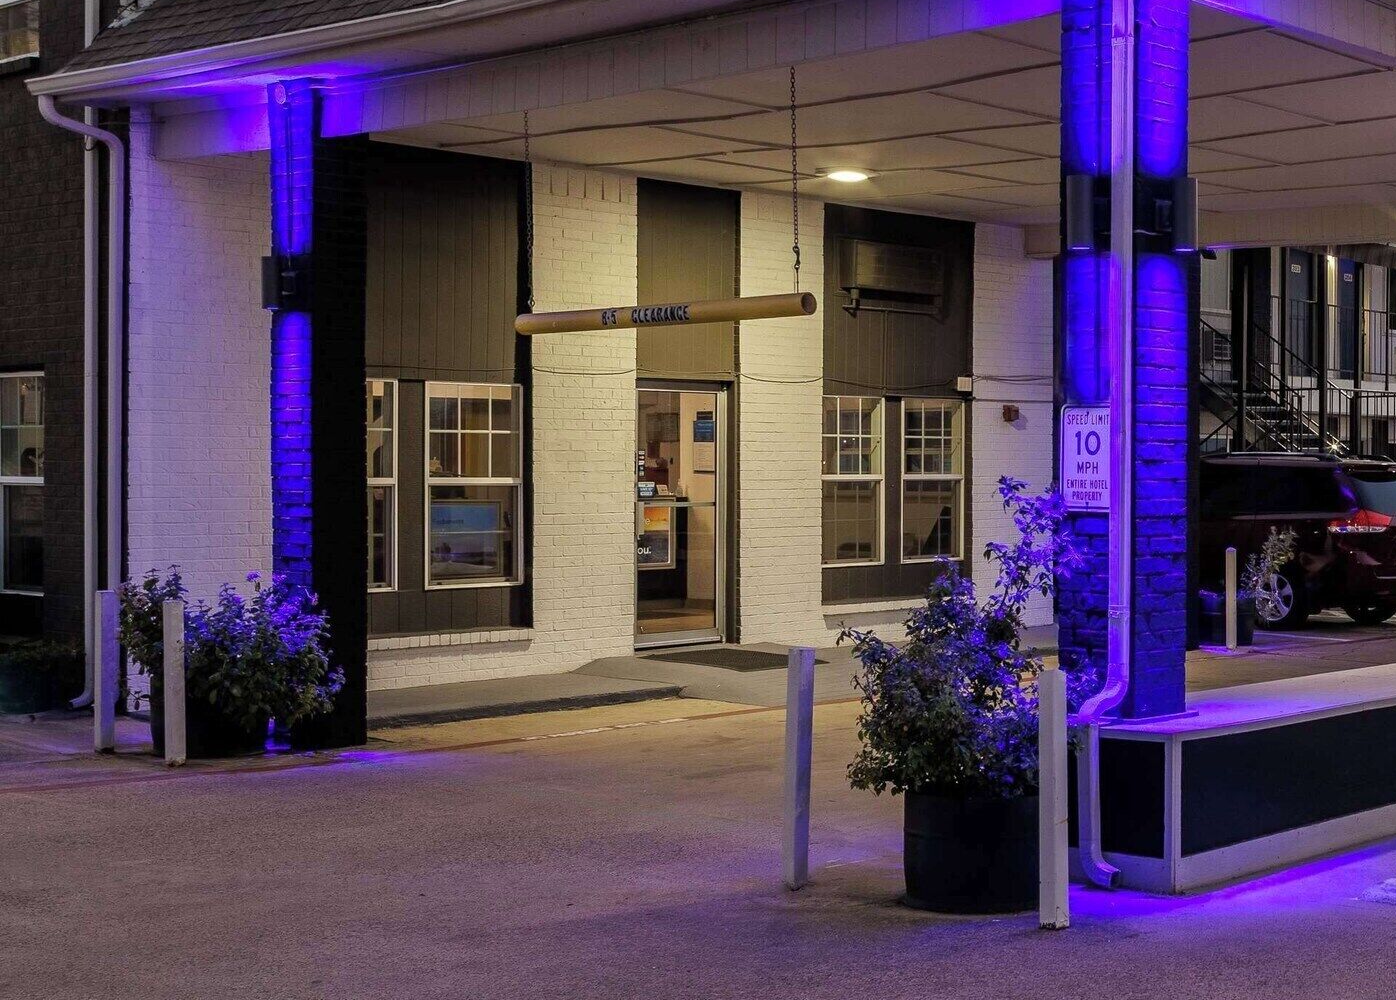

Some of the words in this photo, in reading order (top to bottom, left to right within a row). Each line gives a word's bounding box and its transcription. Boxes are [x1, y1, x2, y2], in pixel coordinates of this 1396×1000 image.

[631, 305, 690, 324] CLEARANCE
[1066, 413, 1089, 426] SPEED
[1091, 413, 1110, 426] LIMIT
[1075, 430, 1101, 456] 10
[1077, 461, 1099, 475] MPH
[1066, 479, 1088, 490] ENTIRE
[1089, 480, 1108, 490] HOTEL
[1072, 491, 1103, 501] PROPERTY
